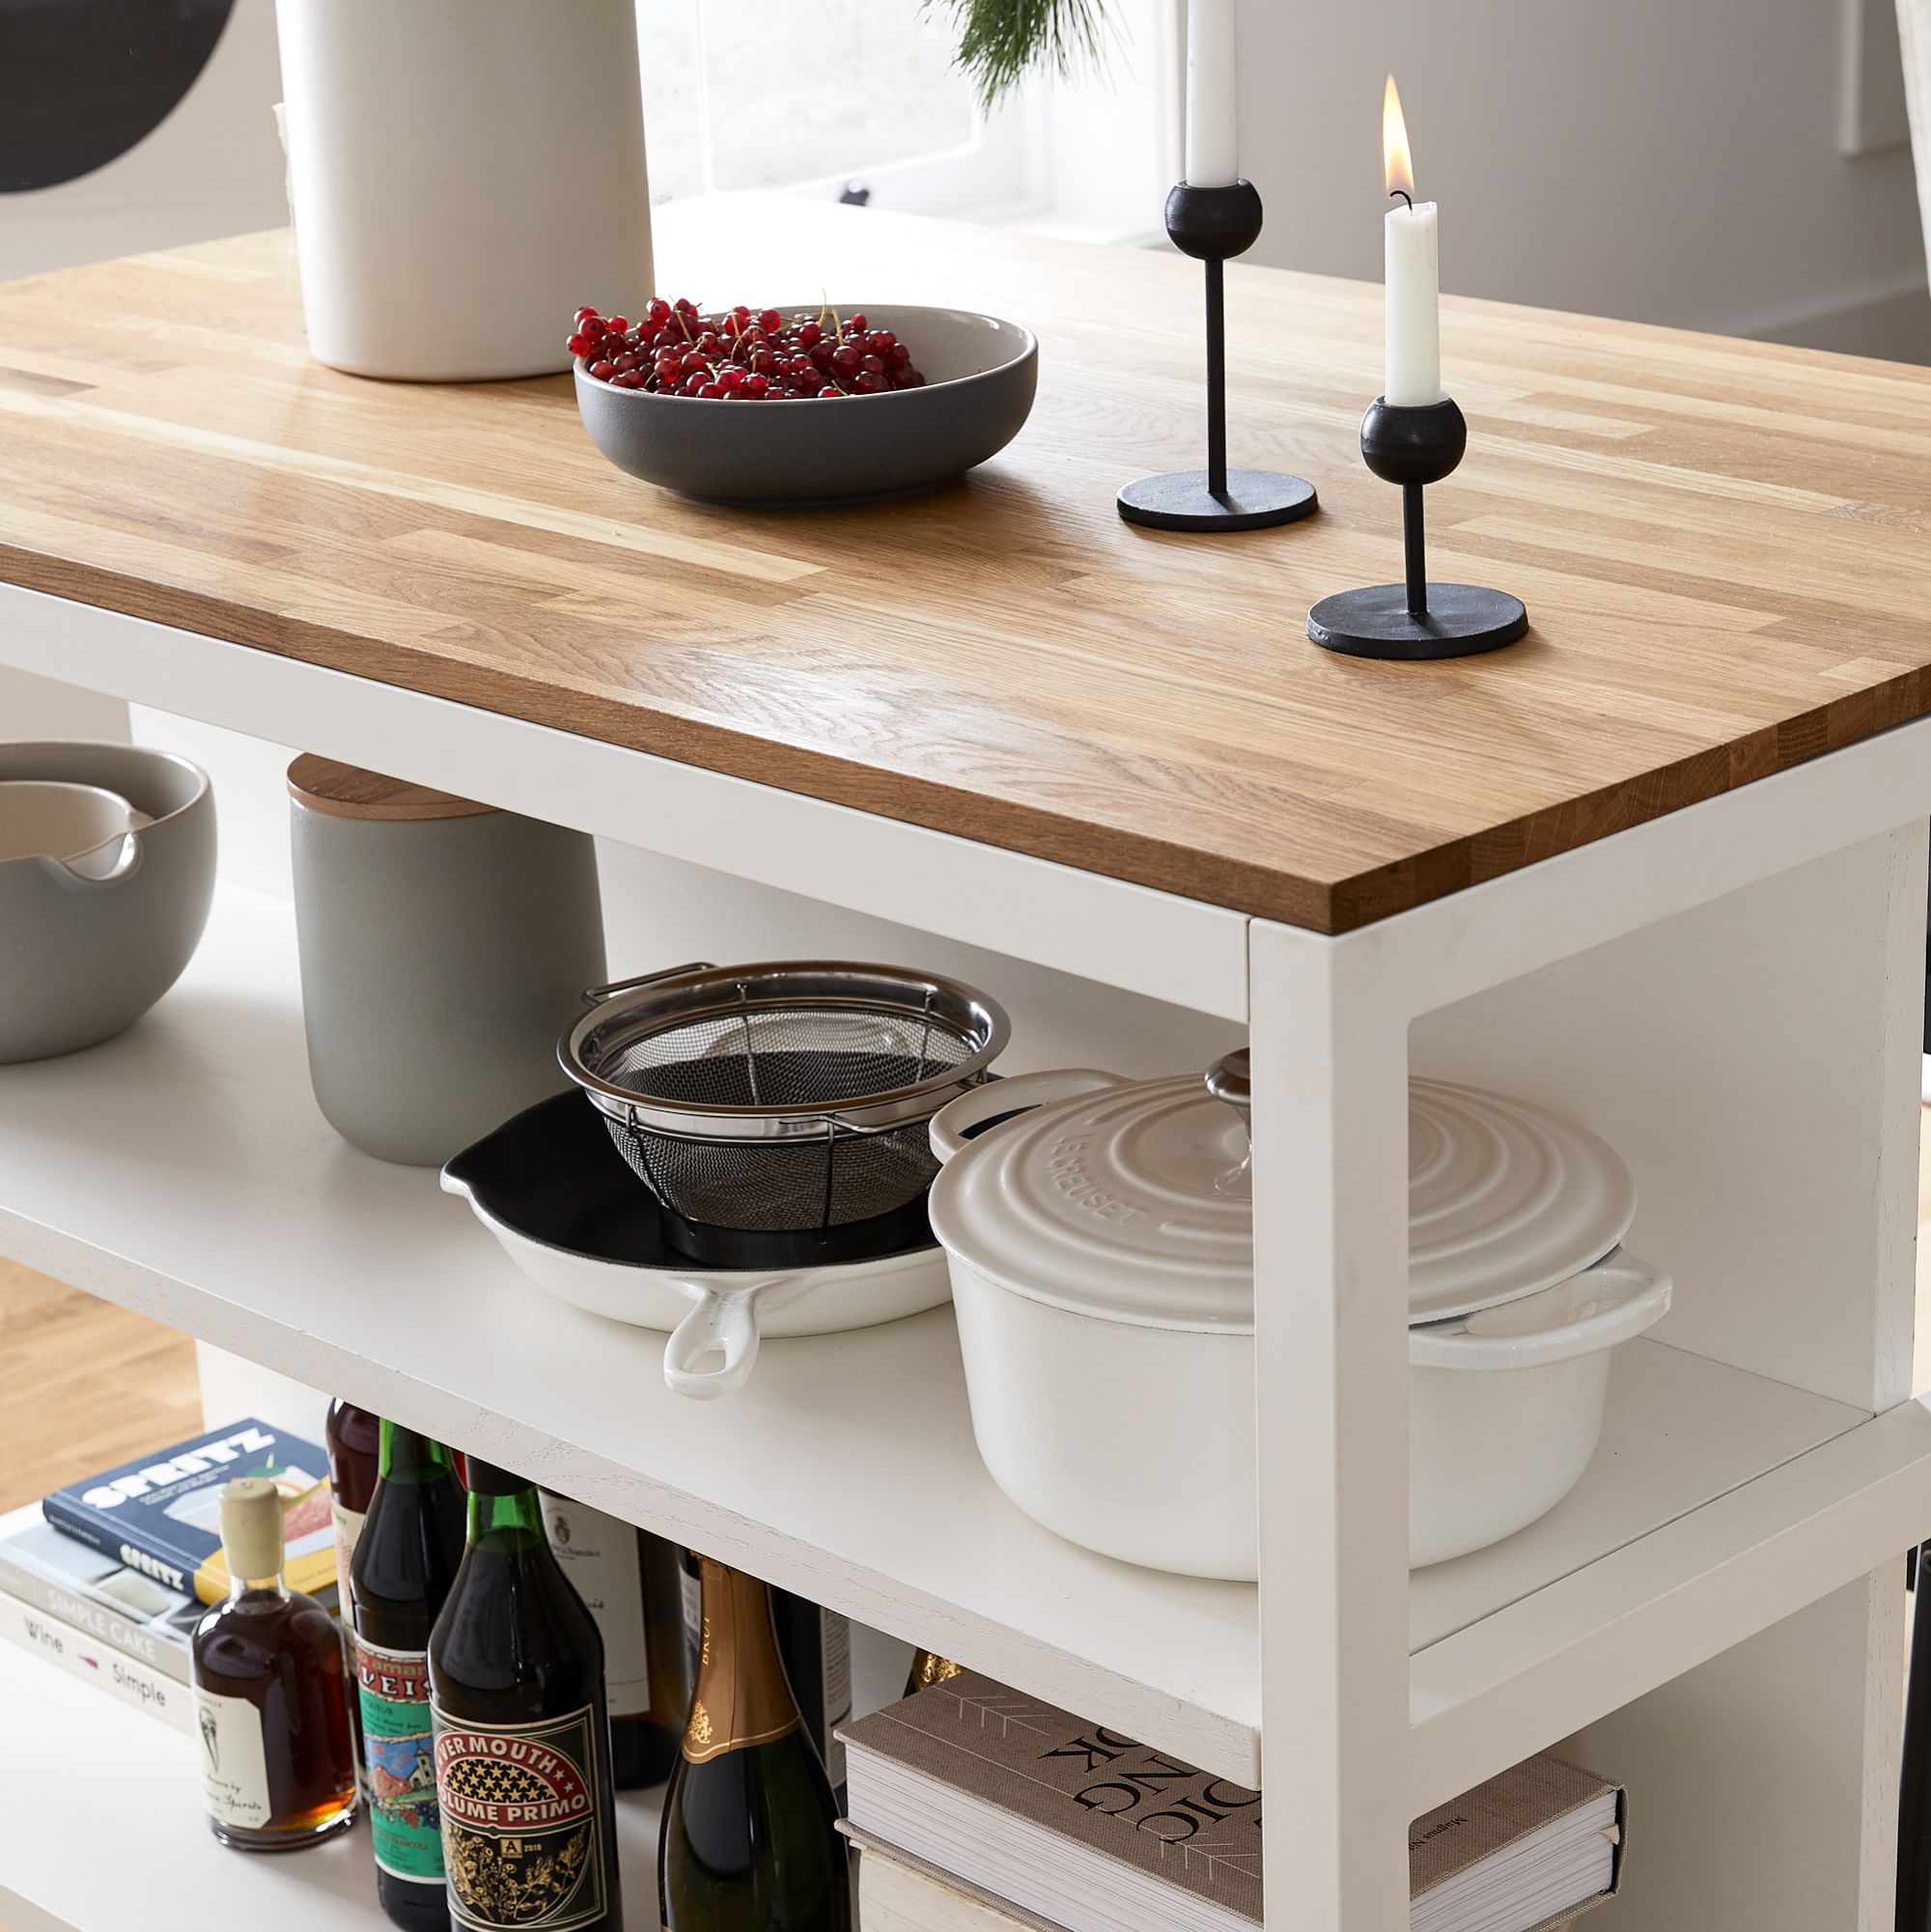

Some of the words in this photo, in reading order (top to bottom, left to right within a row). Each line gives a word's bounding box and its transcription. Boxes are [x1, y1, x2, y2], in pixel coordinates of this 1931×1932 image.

[81, 1427, 277, 1509] SPRITZ
[48, 1588, 107, 1635] SIMPLE
[109, 1623, 156, 1661] CAKE
[24, 1616, 64, 1653] Wine
[112, 1662, 166, 1707] Simple
[438, 1736, 558, 1775] VERMOUTH
[507, 1793, 586, 1822] PRIMO
[1422, 1815, 1468, 1840] Magnus
